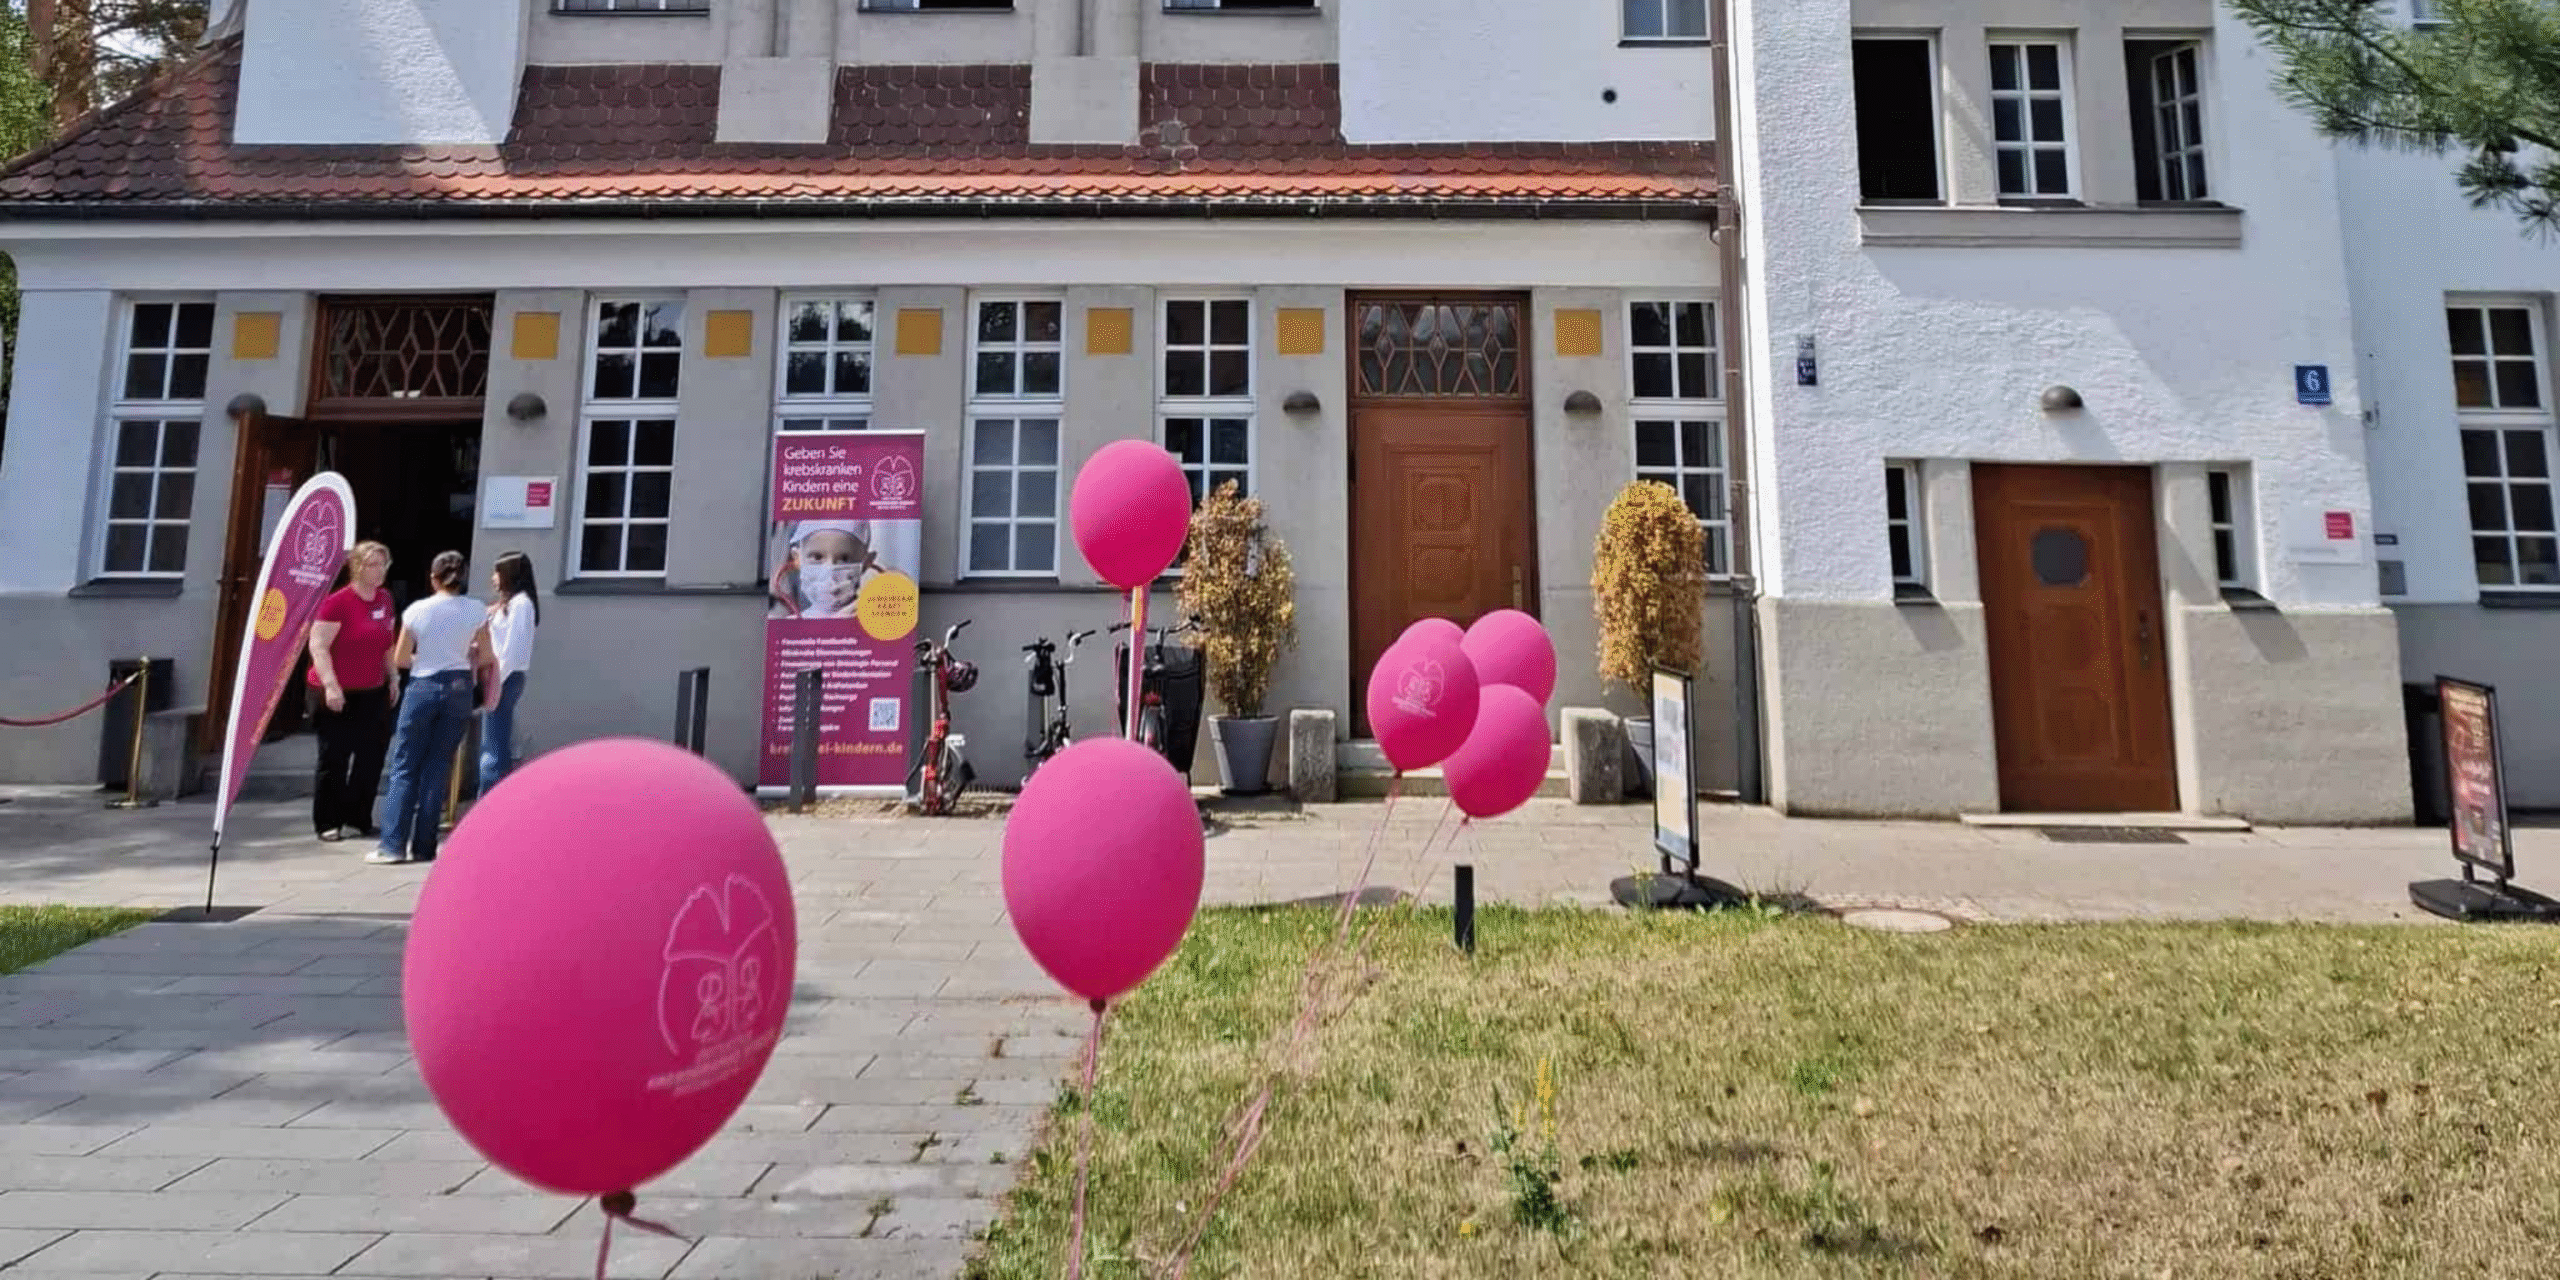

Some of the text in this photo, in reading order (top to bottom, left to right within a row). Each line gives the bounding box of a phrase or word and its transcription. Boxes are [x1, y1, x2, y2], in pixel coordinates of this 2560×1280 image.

[2306, 370, 2320, 391] 6
[784, 446, 847, 460] Geben Sie
[783, 463, 862, 476] krebskranken
[782, 480, 859, 493] Kindern eine
[781, 497, 857, 511] ZUKUNFT
